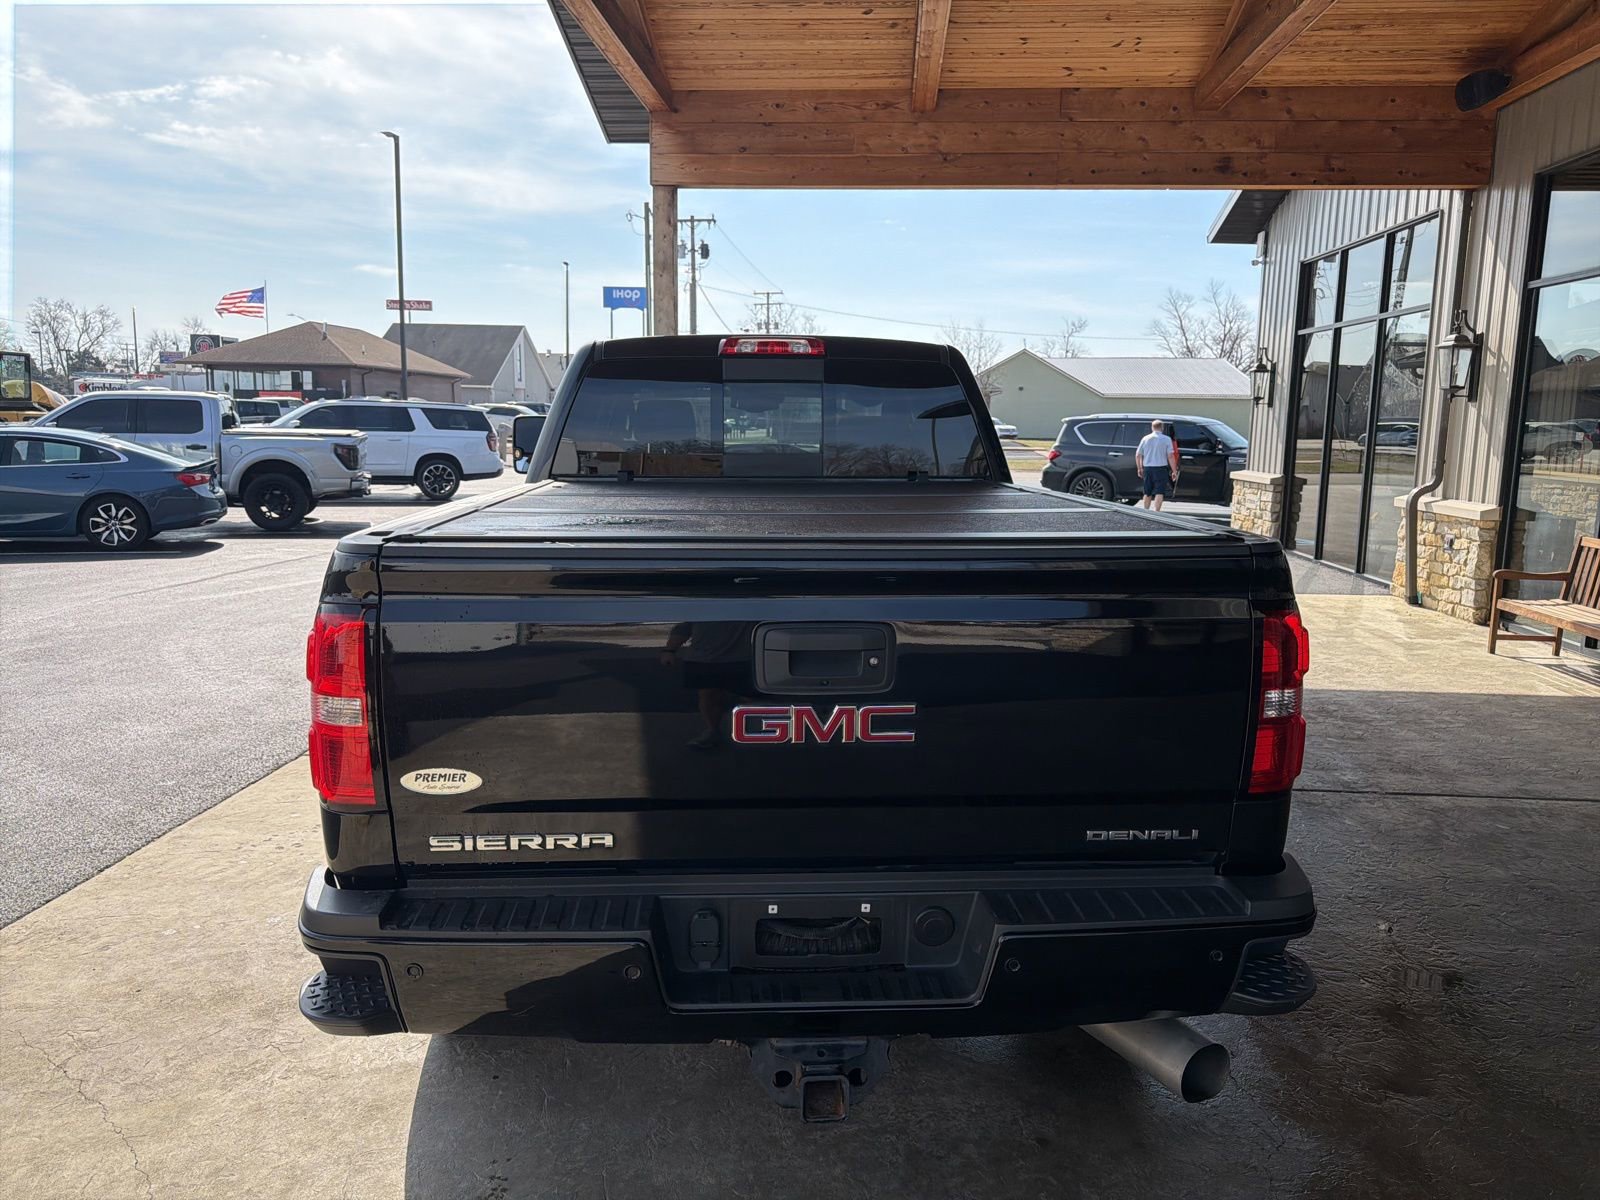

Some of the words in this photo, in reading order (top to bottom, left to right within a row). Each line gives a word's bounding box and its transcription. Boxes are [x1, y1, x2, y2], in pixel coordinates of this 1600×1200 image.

[387, 301, 403, 309] Stea
[732, 704, 916, 744] GMC
[414, 773, 467, 783] PREMIER
[1086, 828, 1199, 841] DENALI
[429, 833, 614, 852] SIERRA
